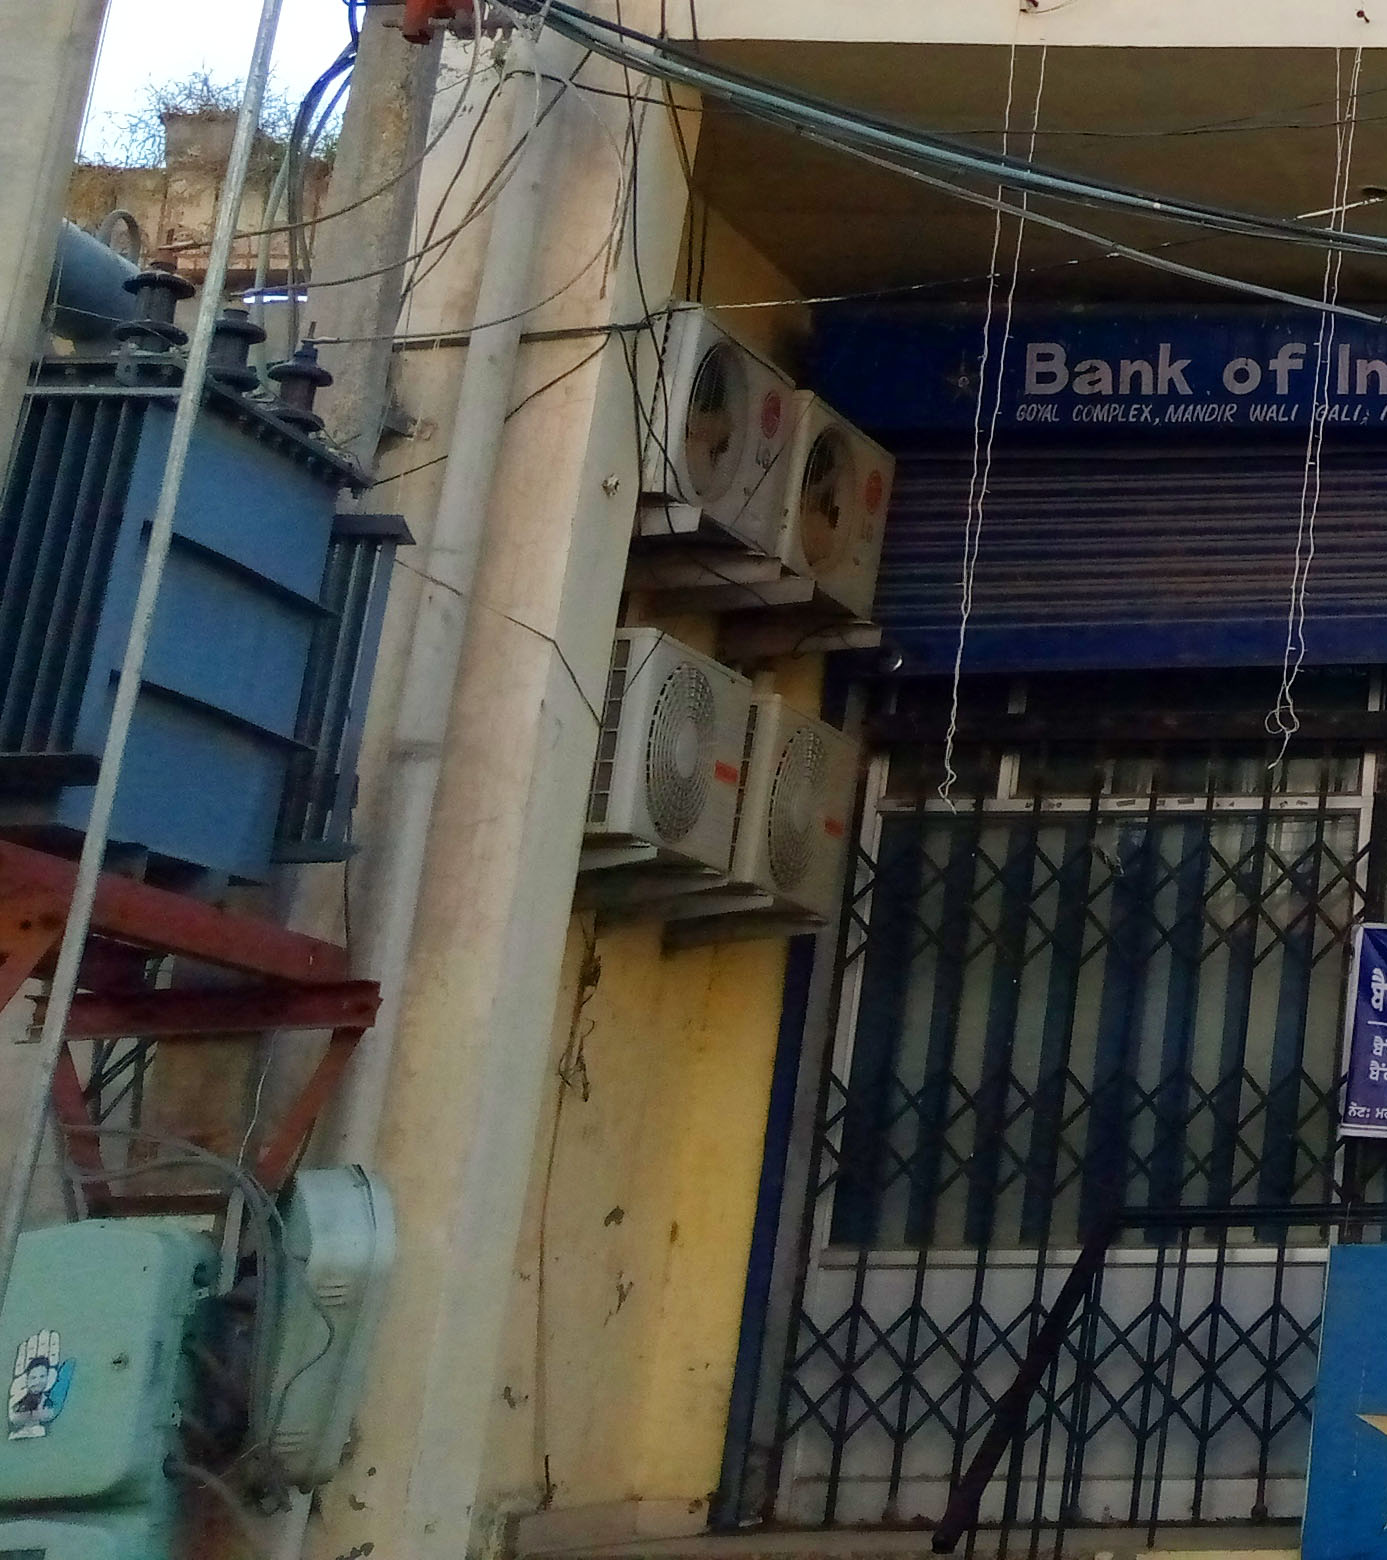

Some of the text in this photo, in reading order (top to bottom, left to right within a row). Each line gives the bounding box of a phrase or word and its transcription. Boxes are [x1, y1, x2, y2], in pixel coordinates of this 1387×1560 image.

[1025, 342, 1193, 396] Bank
[1223, 342, 1307, 396] of
[1016, 402, 1060, 424] GOYAL
[1072, 402, 1161, 427] COMPLEX,
[1164, 402, 1238, 424] MANDIR
[1249, 402, 1299, 424] WALI
